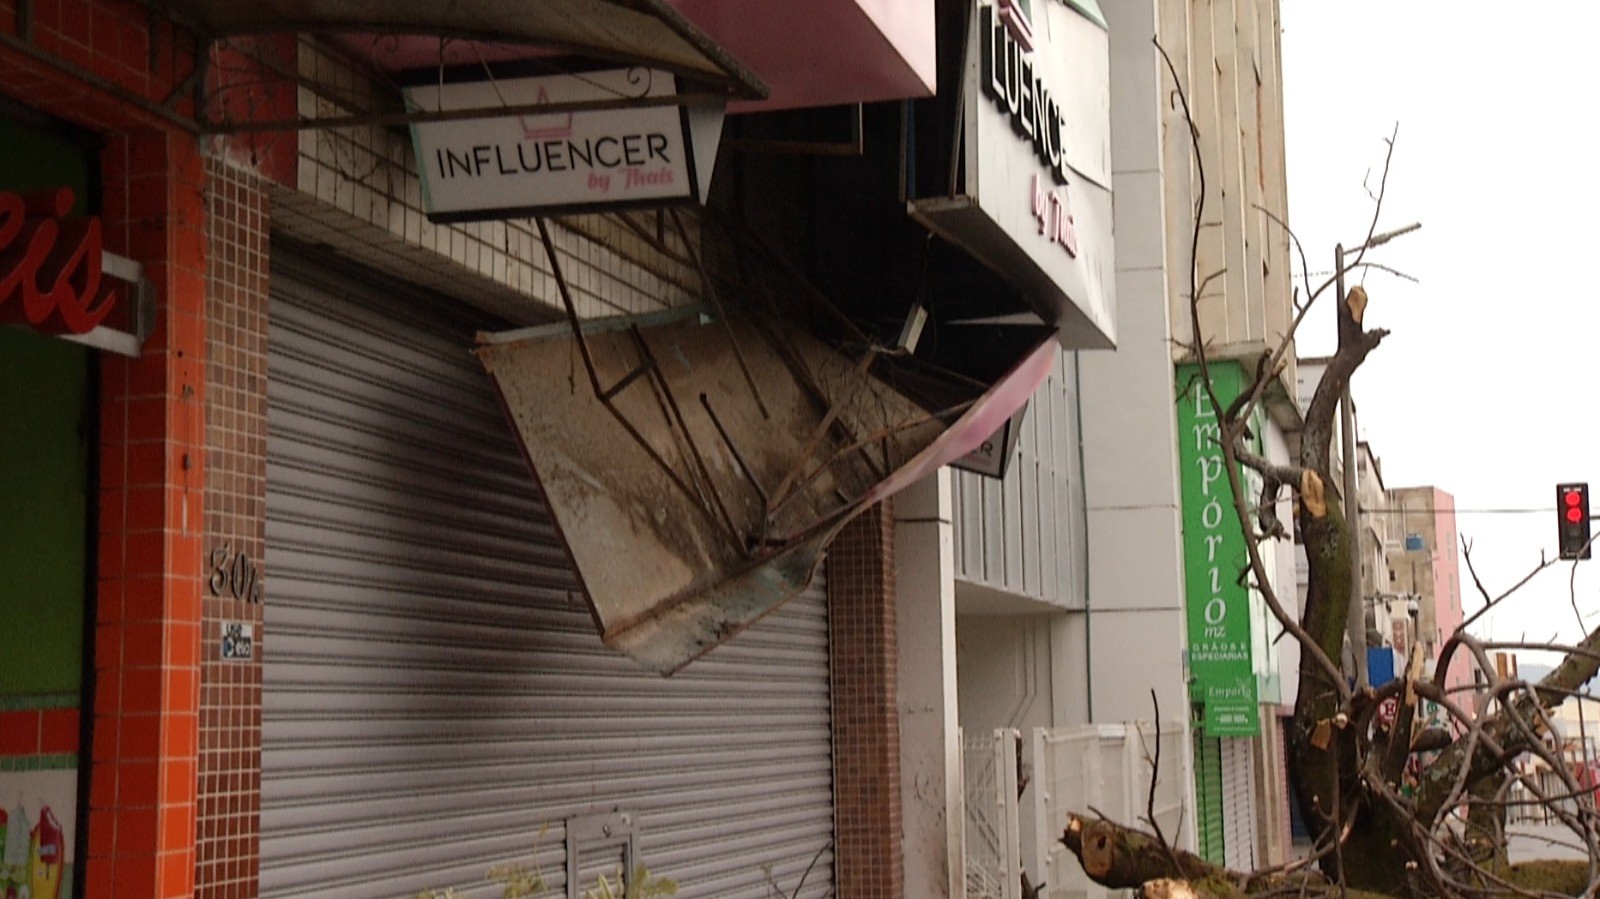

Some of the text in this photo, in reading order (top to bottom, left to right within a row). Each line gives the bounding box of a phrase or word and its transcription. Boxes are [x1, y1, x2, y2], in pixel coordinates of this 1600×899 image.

[436, 132, 673, 179] INFLUENCER
[587, 165, 675, 194] by Thais
[1205, 626, 1226, 638] mz
[1191, 652, 1249, 661] ESPECIARIAS
